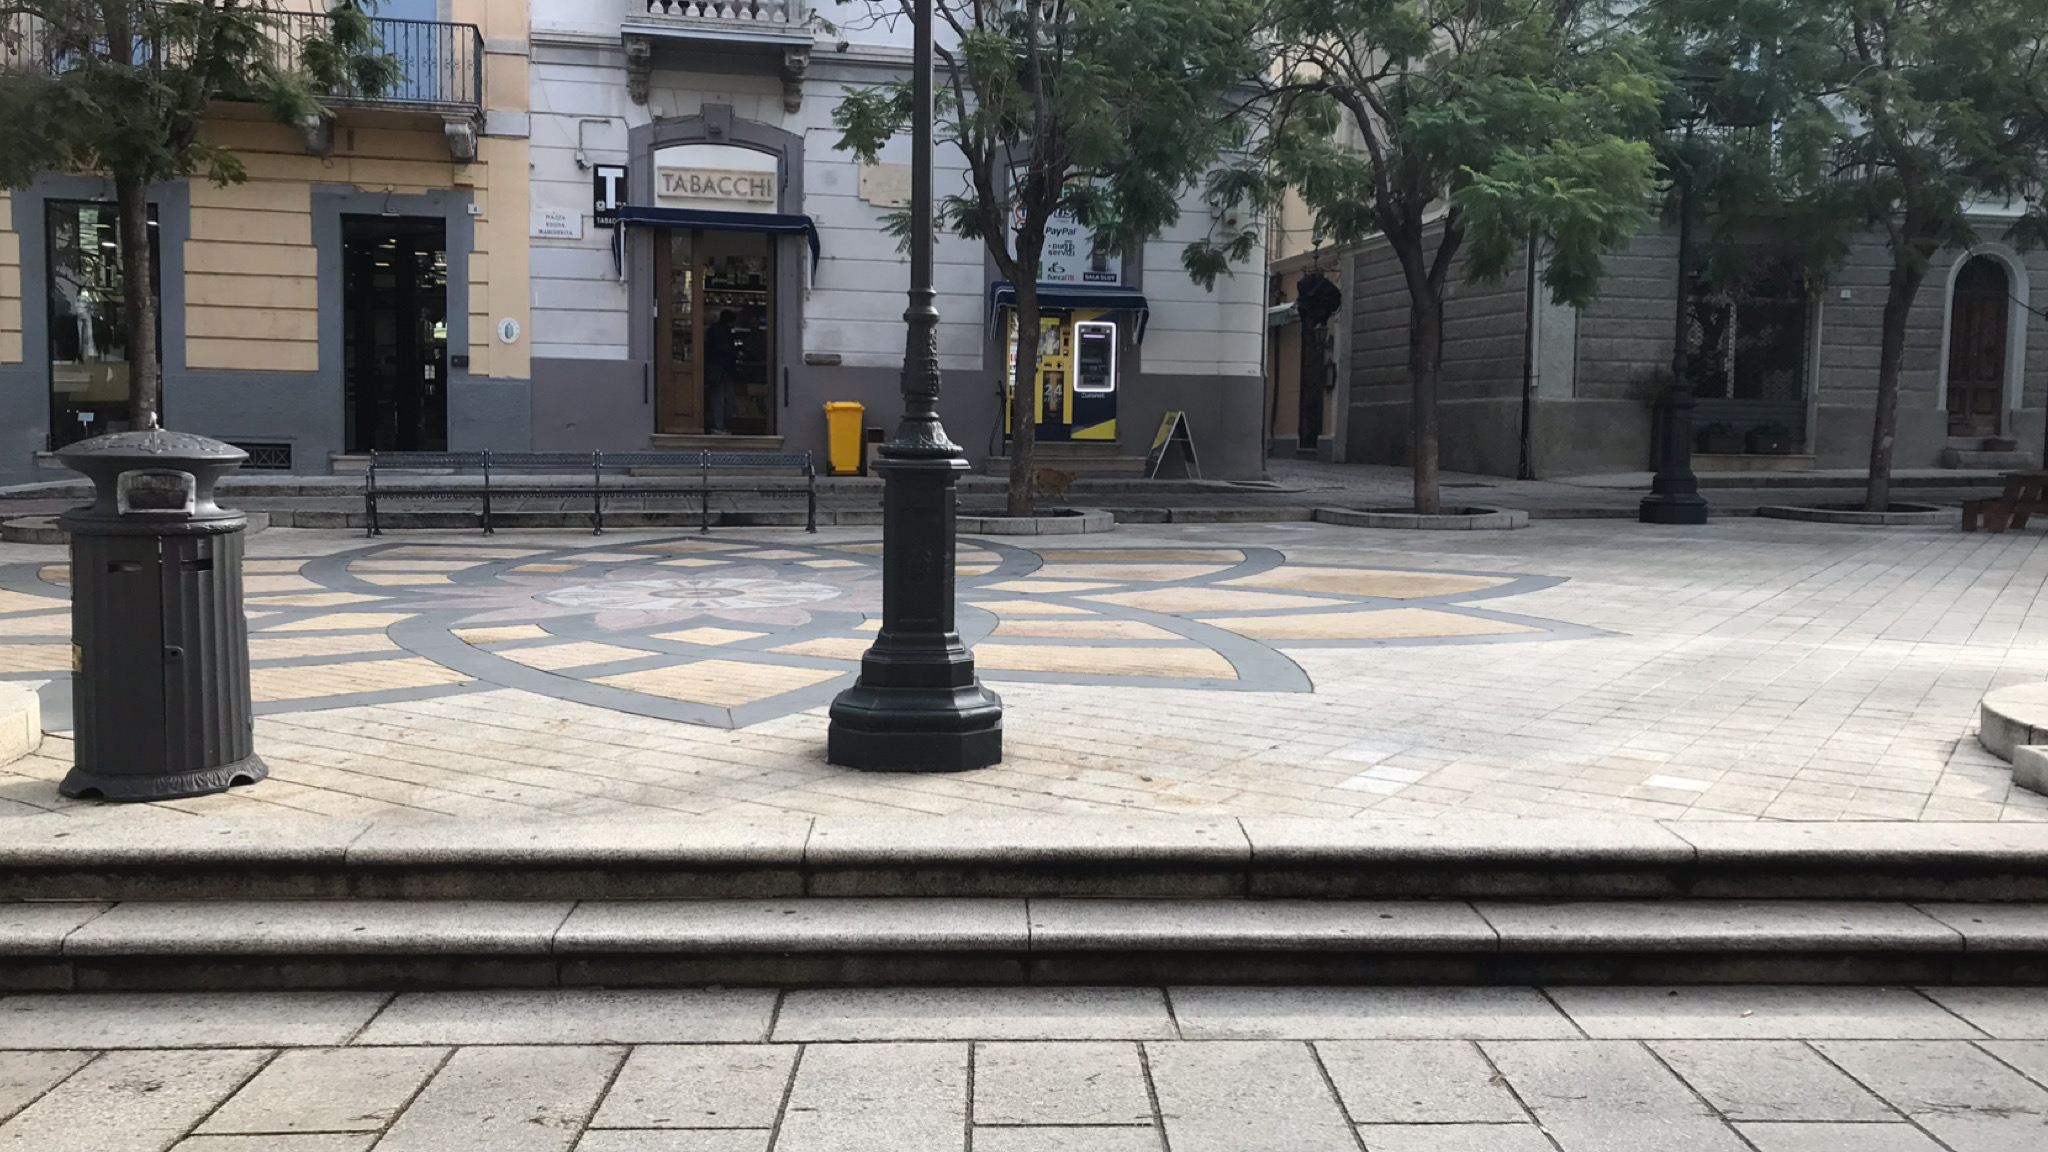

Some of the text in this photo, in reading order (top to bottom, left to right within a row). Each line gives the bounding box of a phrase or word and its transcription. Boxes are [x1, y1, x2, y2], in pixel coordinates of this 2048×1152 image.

[598, 167, 624, 209] T
[661, 173, 772, 197] TABACCHI
[1045, 226, 1076, 237] PayPal
[1044, 384, 1063, 395] 24
